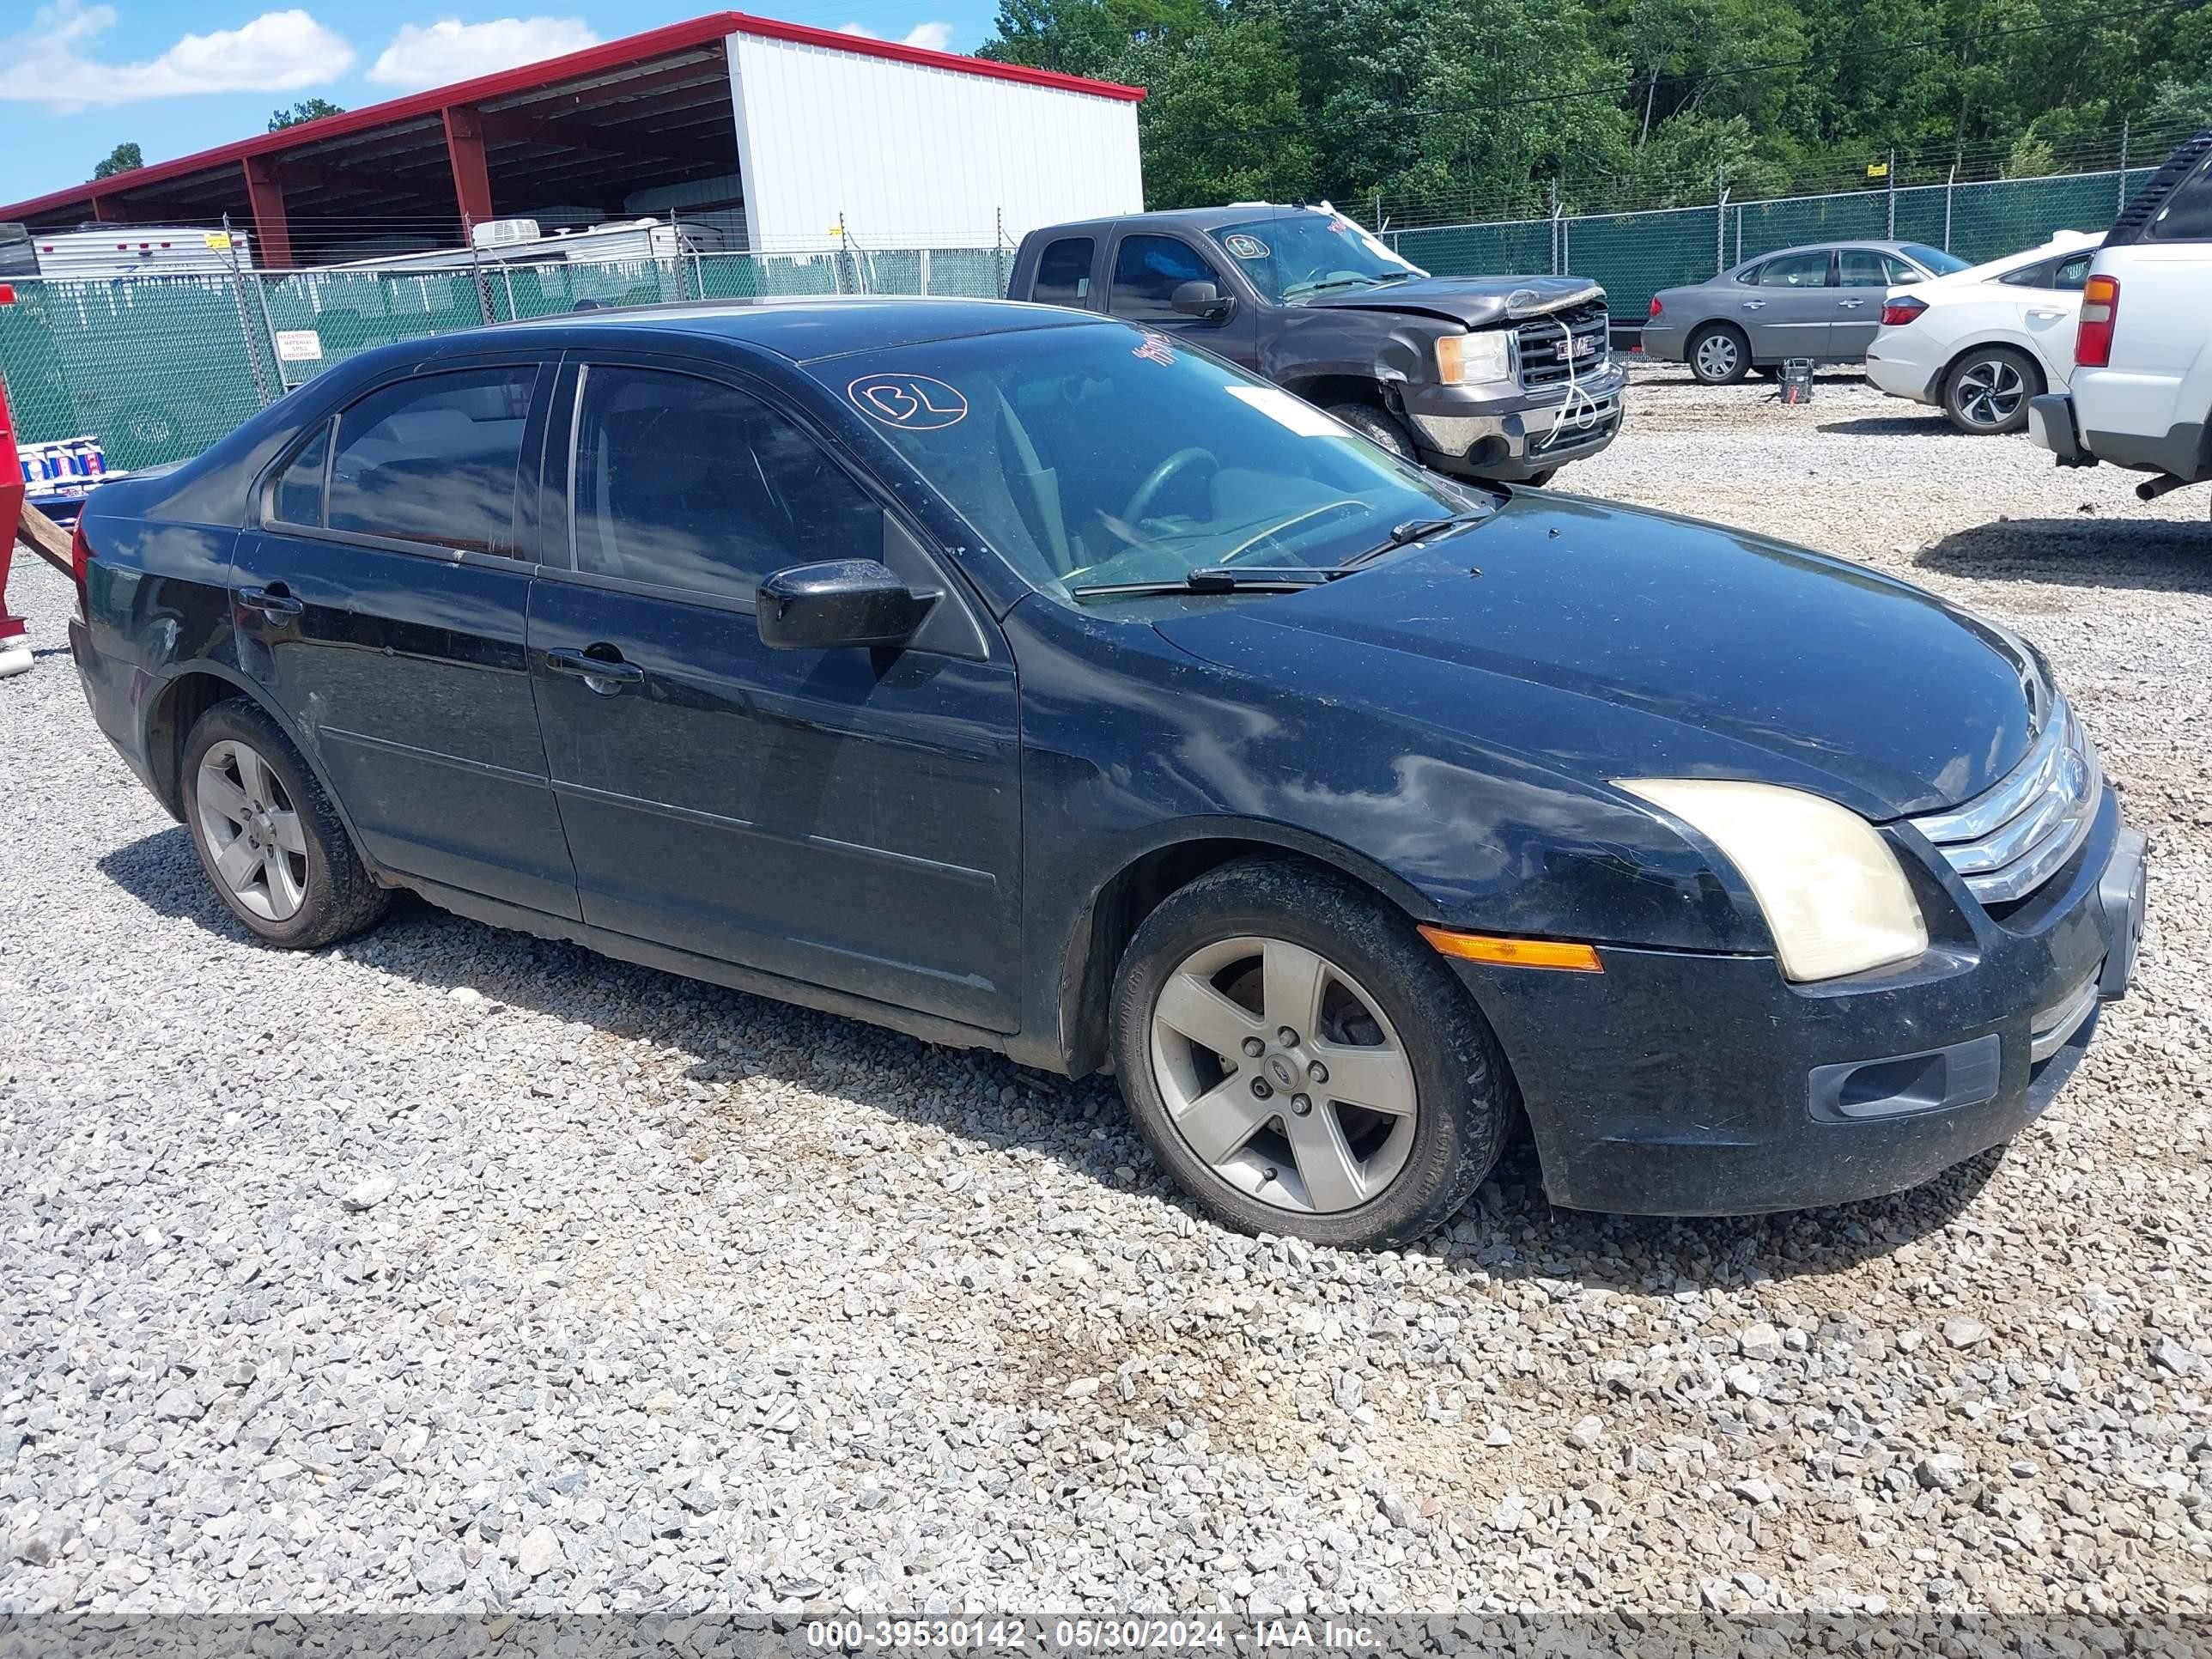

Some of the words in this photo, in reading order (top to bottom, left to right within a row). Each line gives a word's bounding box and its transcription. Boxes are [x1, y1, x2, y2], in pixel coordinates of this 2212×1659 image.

[1231, 238, 1267, 256] BL
[1556, 335, 1595, 360] GMC
[861, 383, 965, 420] BL
